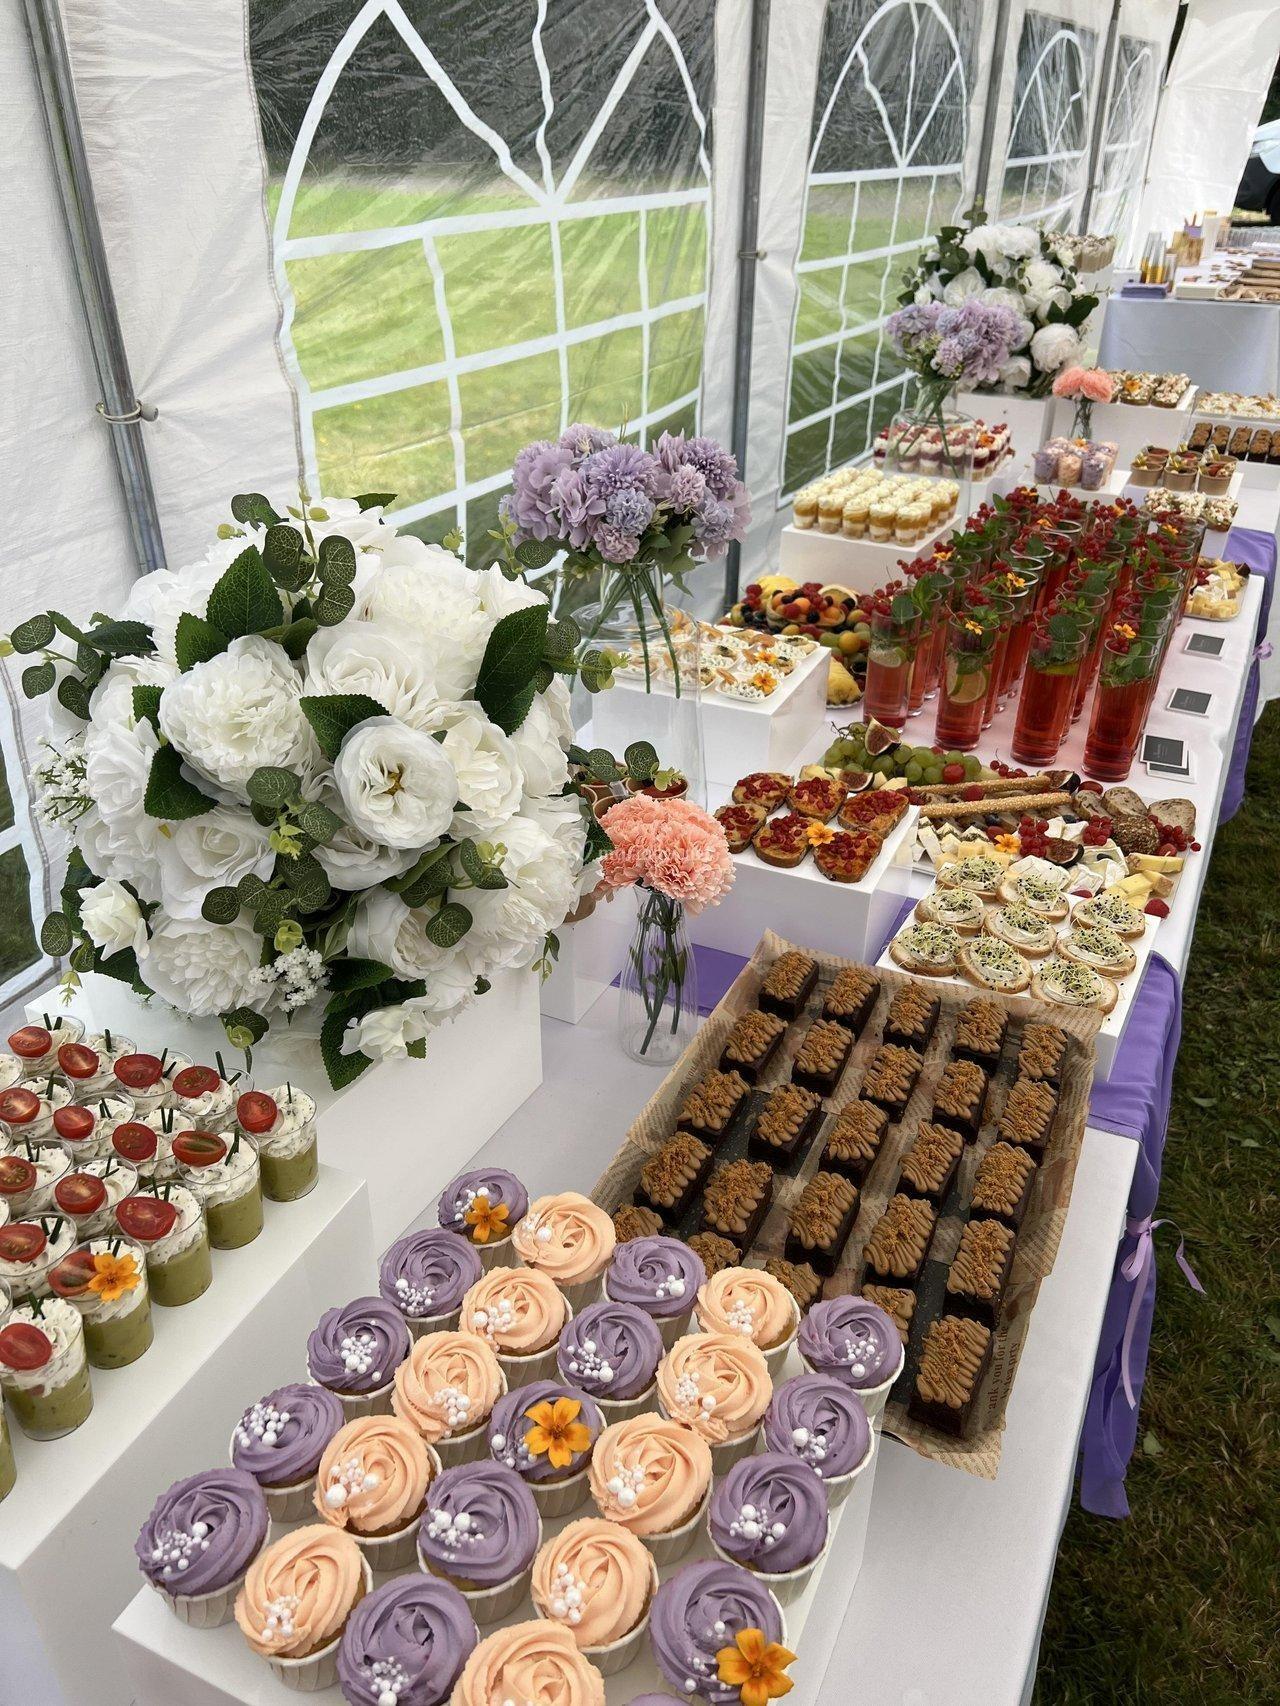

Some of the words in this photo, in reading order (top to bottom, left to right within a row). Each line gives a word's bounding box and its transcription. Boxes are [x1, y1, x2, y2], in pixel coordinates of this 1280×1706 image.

[997, 1326, 1009, 1342] the
[996, 1345, 1006, 1361] for
[992, 1363, 1003, 1386] you
[987, 1386, 999, 1410] ank
